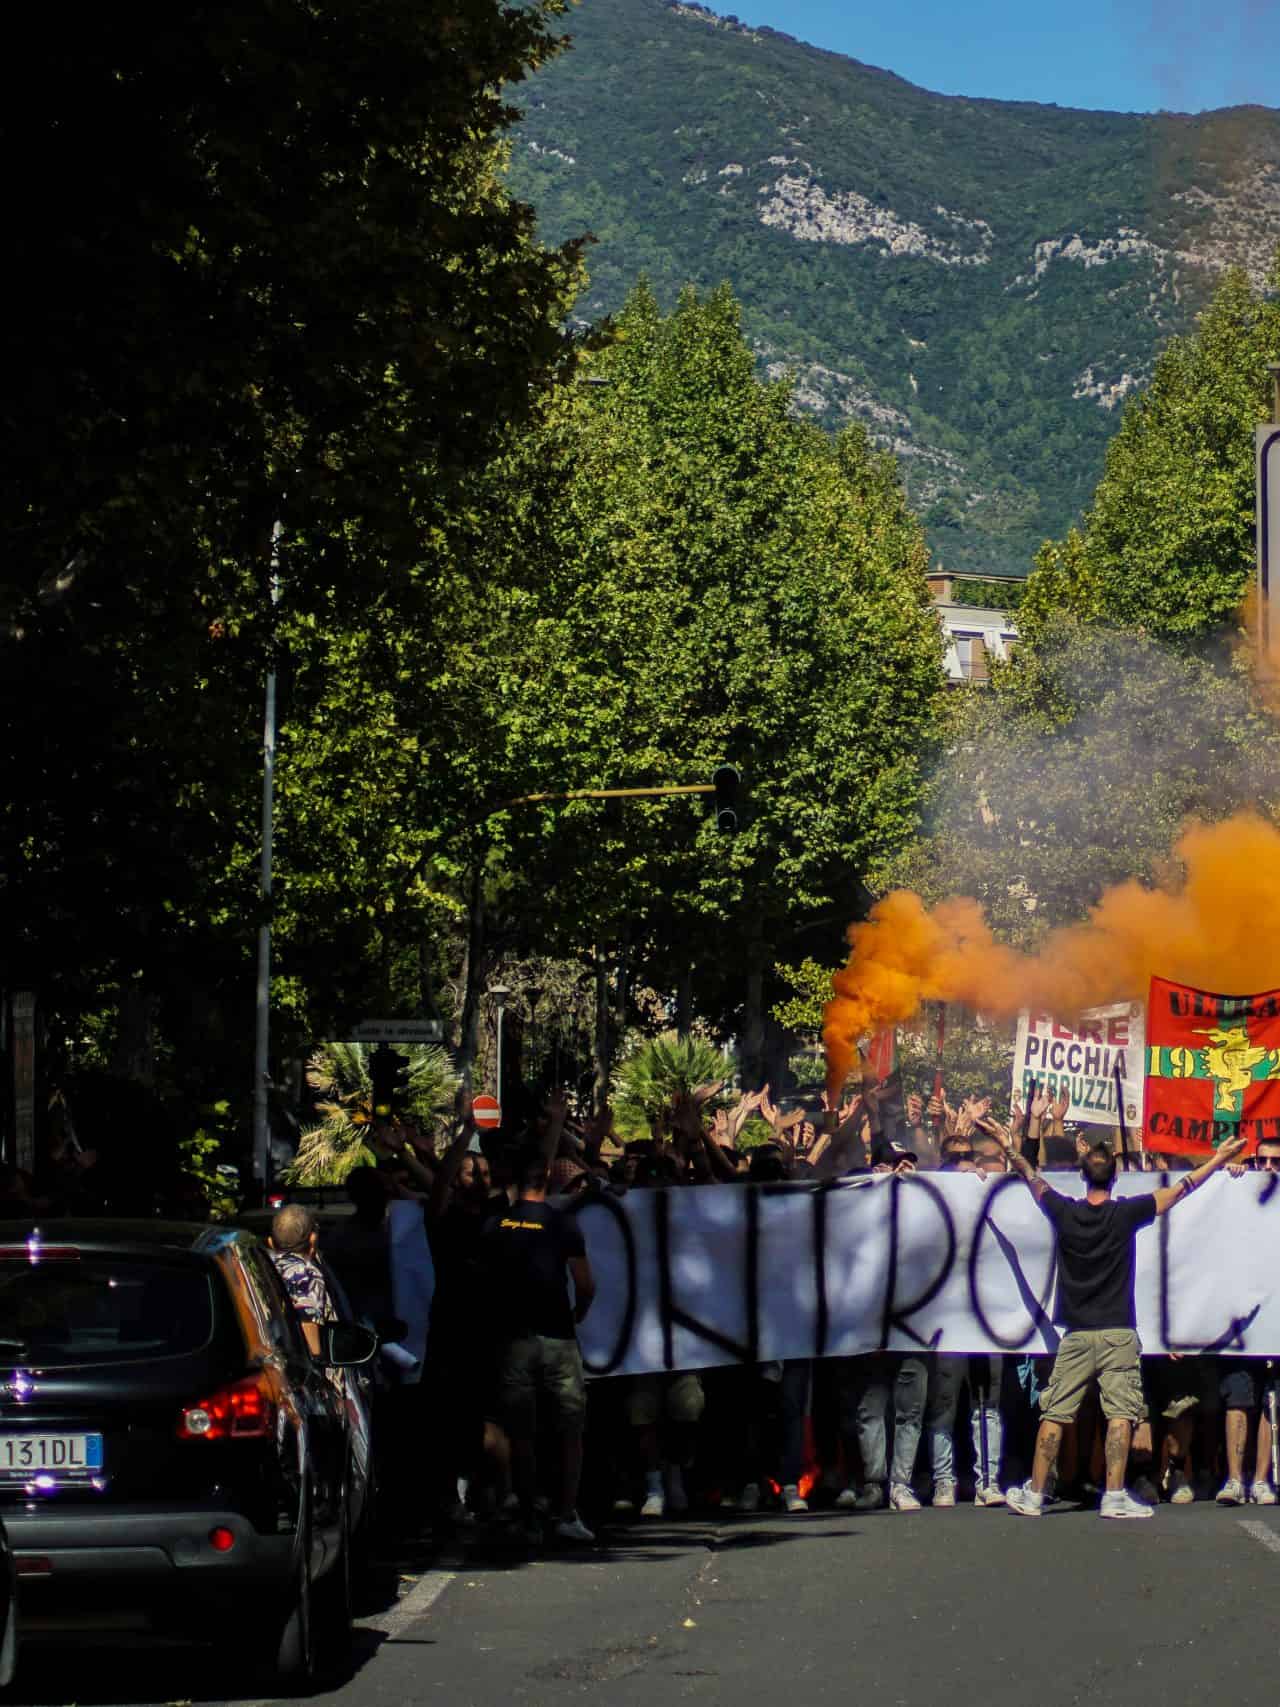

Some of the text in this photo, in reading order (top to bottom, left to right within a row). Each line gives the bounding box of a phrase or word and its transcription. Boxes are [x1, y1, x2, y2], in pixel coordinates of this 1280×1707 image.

[1024, 1035, 1128, 1080] PICCHIA
[570, 1172, 1057, 1375] ONTRO
[6, 1439, 84, 1466] 131DL
